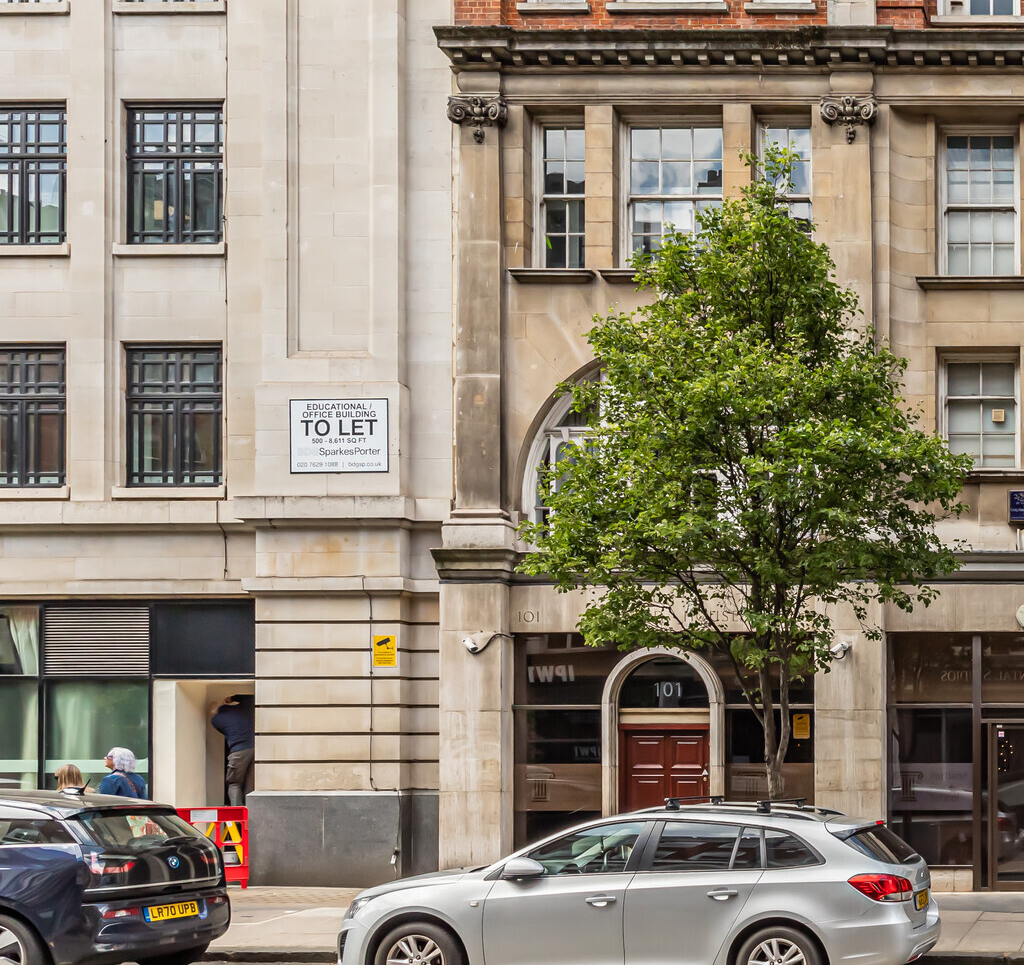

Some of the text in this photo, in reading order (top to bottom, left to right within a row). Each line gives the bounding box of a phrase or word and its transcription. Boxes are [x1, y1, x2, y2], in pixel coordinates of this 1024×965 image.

[306, 403, 367, 411] EDUCATIONAL
[335, 410, 376, 418] BUILDING
[300, 419, 378, 436] TO LET
[328, 437, 345, 445] 8,611
[517, 610, 540, 623] 101
[653, 682, 682, 698] 101
[150, 902, 197, 919] LR70 UPB
